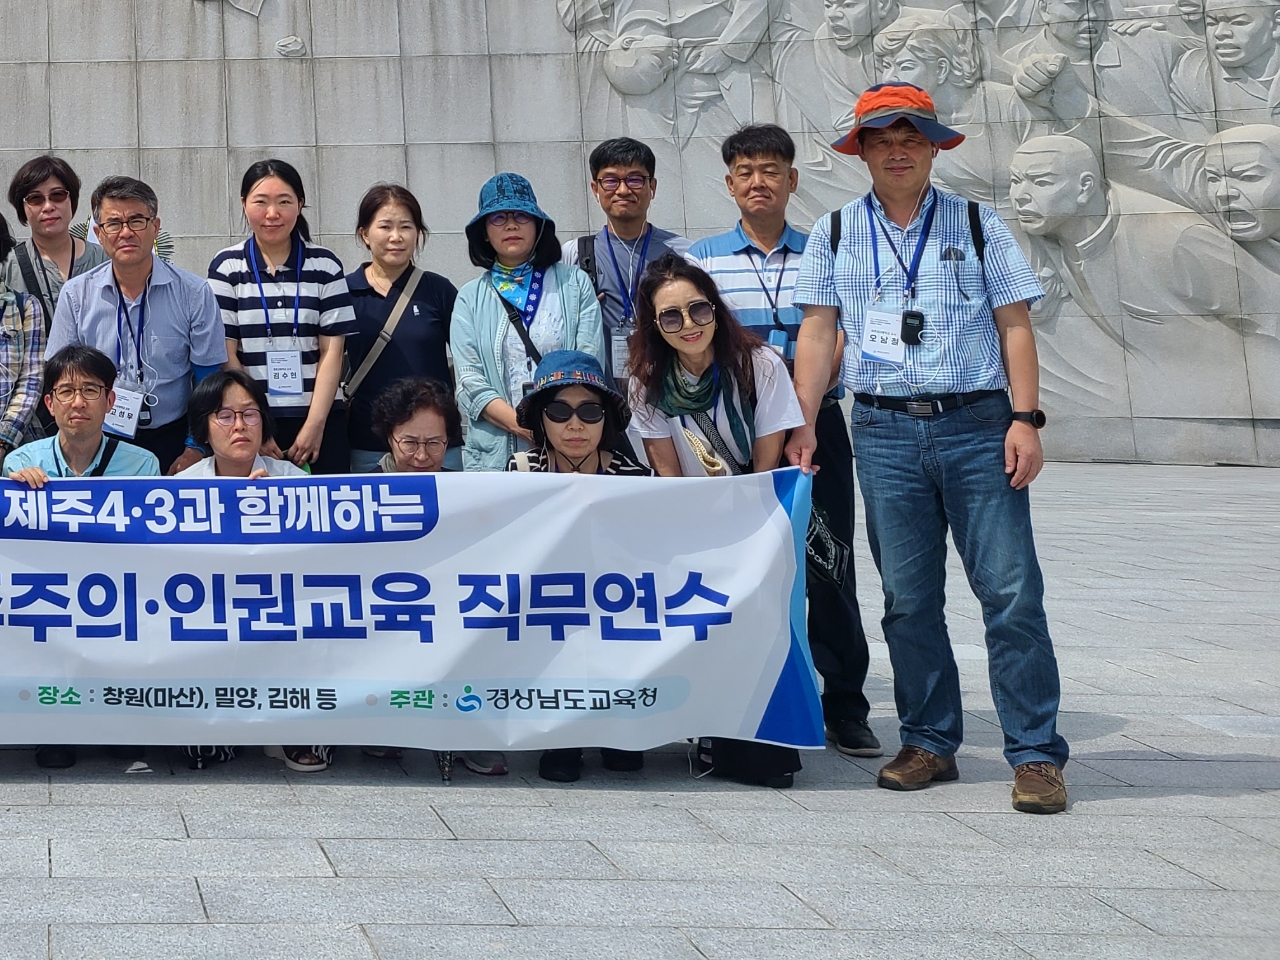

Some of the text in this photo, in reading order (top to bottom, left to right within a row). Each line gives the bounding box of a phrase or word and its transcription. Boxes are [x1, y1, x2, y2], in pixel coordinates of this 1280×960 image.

[4, 488, 225, 534] 제주4·3과
[236, 484, 425, 534] 함께하는
[458, 571, 733, 642] 직무연수
[37, 685, 82, 706] 장소
[103, 686, 209, 709] 창원(마산),
[215, 687, 262, 710] 밀양,
[268, 687, 310, 710] 김해
[316, 688, 337, 710] 등
[389, 689, 436, 710] 주관
[486, 687, 658, 710] 경상남도교육청
